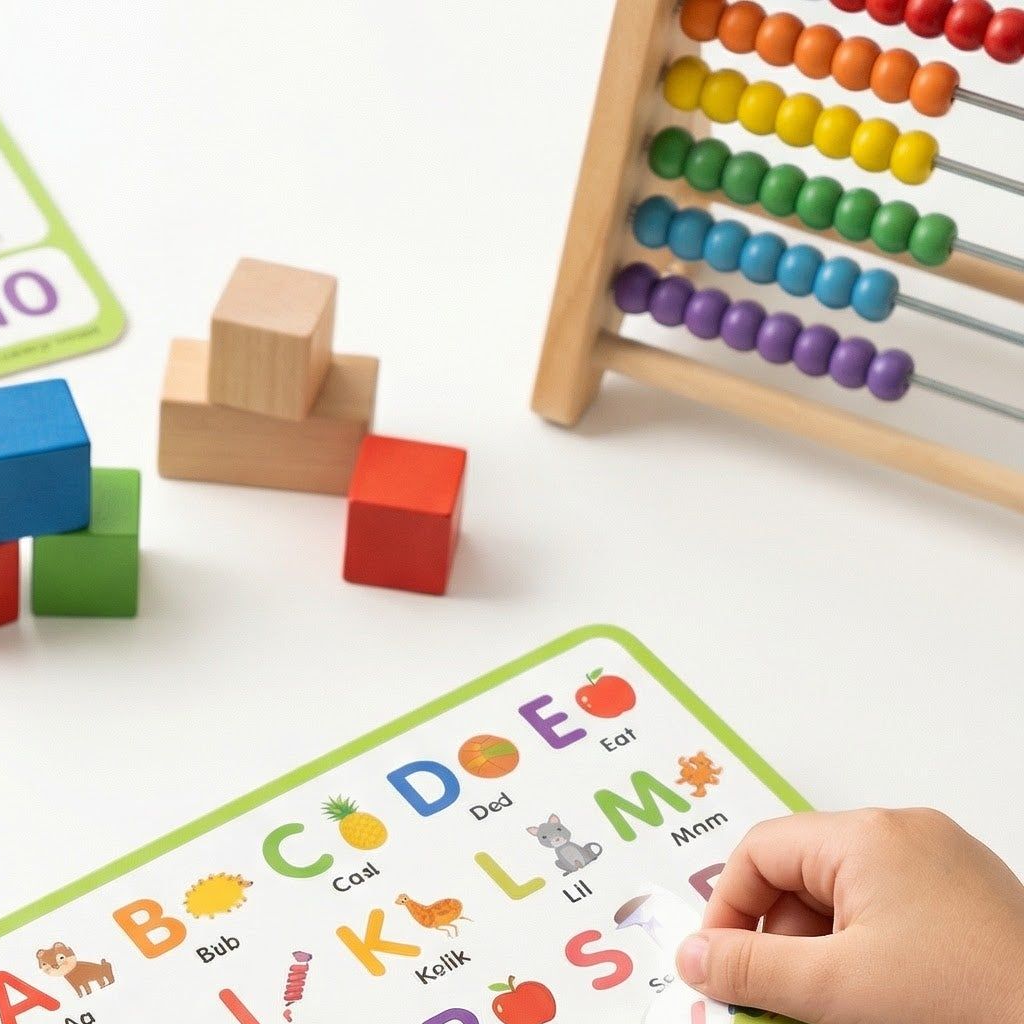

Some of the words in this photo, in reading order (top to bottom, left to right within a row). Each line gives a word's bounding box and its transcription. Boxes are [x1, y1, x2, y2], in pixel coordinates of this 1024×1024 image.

[599, 728, 637, 752] Eat
[113, 899, 187, 959] B
[262, 823, 334, 878] C
[387, 761, 460, 817] D
[518, 695, 587, 749] E
[469, 792, 513, 821] Ded
[336, 909, 421, 976] K
[474, 852, 546, 900] L
[594, 771, 691, 842] M
[565, 930, 633, 990] S
